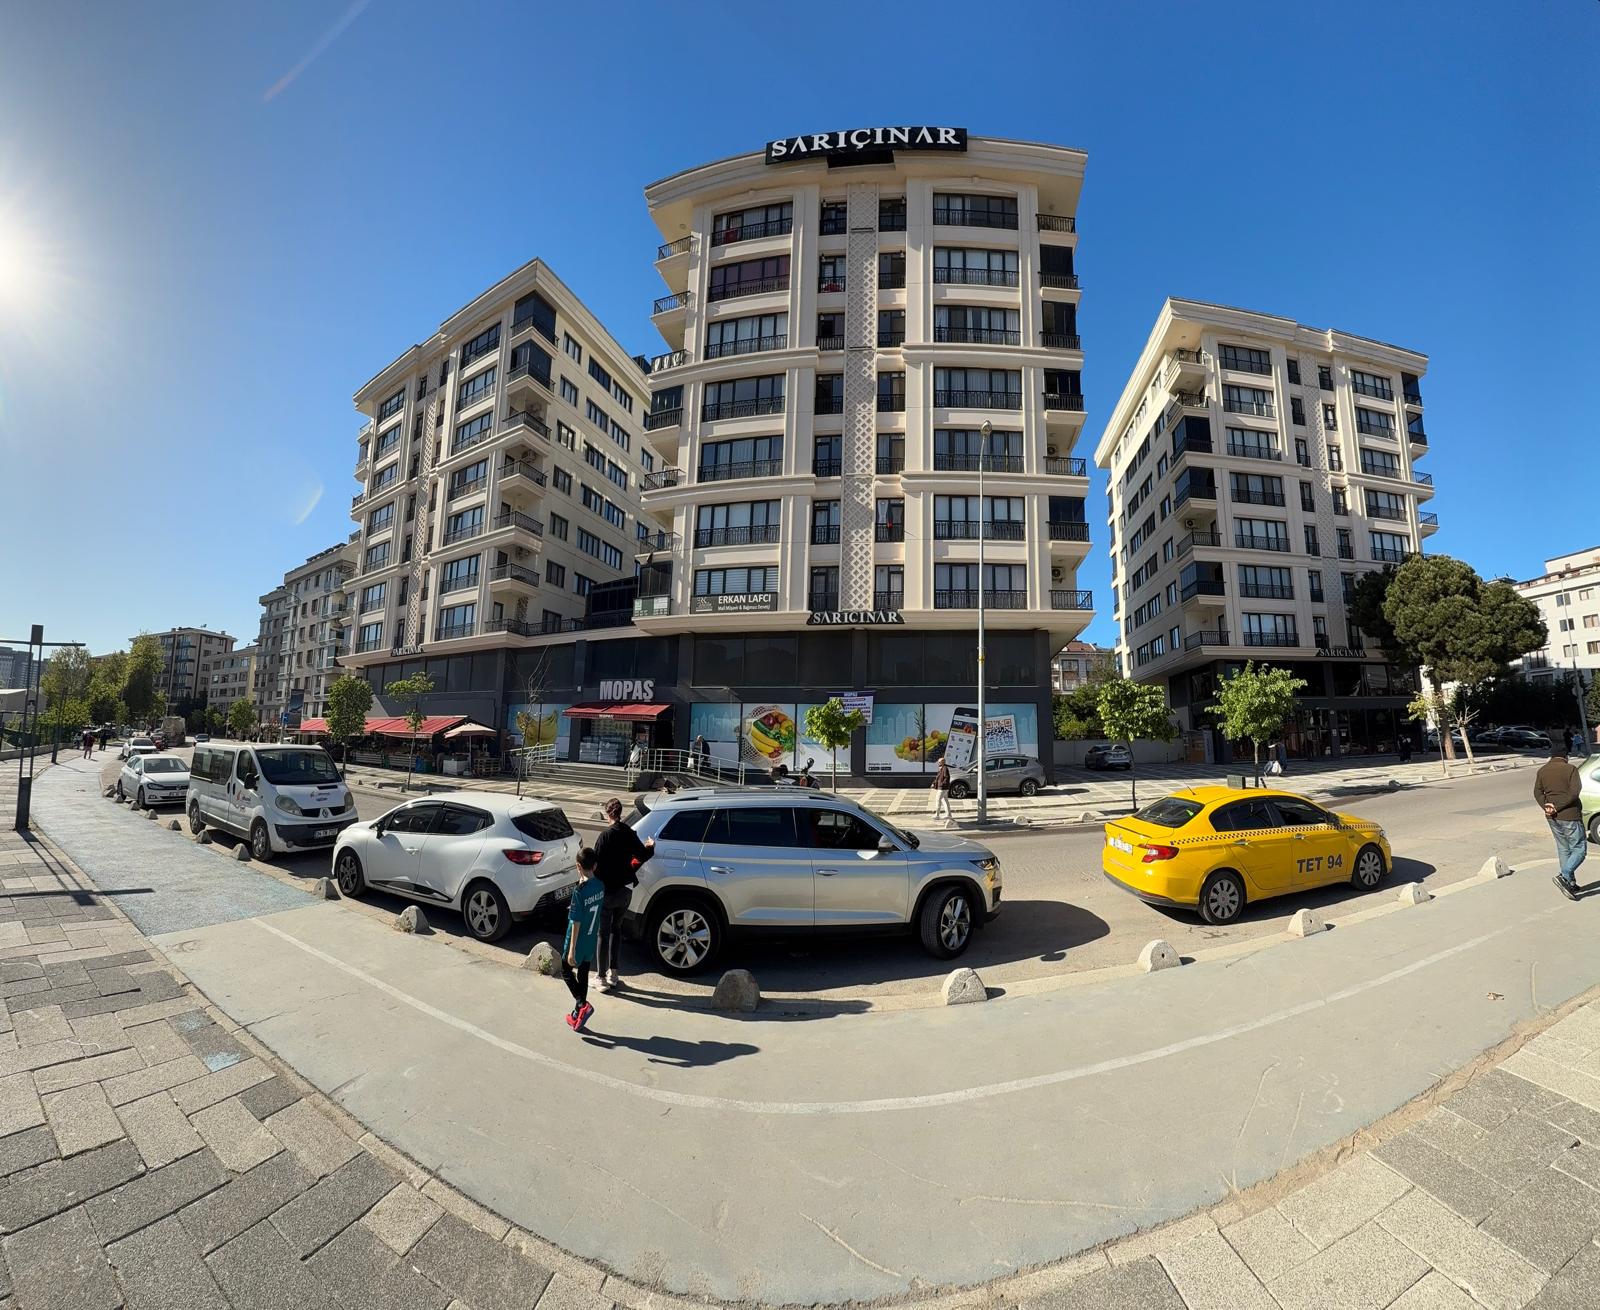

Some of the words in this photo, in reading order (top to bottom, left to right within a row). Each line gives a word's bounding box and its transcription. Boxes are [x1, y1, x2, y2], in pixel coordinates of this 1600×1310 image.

[771, 126, 961, 157] SARIÇINAR
[718, 594, 746, 604] ERKAN
[600, 680, 654, 702] MOPAŞ
[1297, 856, 1323, 873] TET
[1328, 854, 1342, 869] 94
[587, 905, 599, 935] 7
